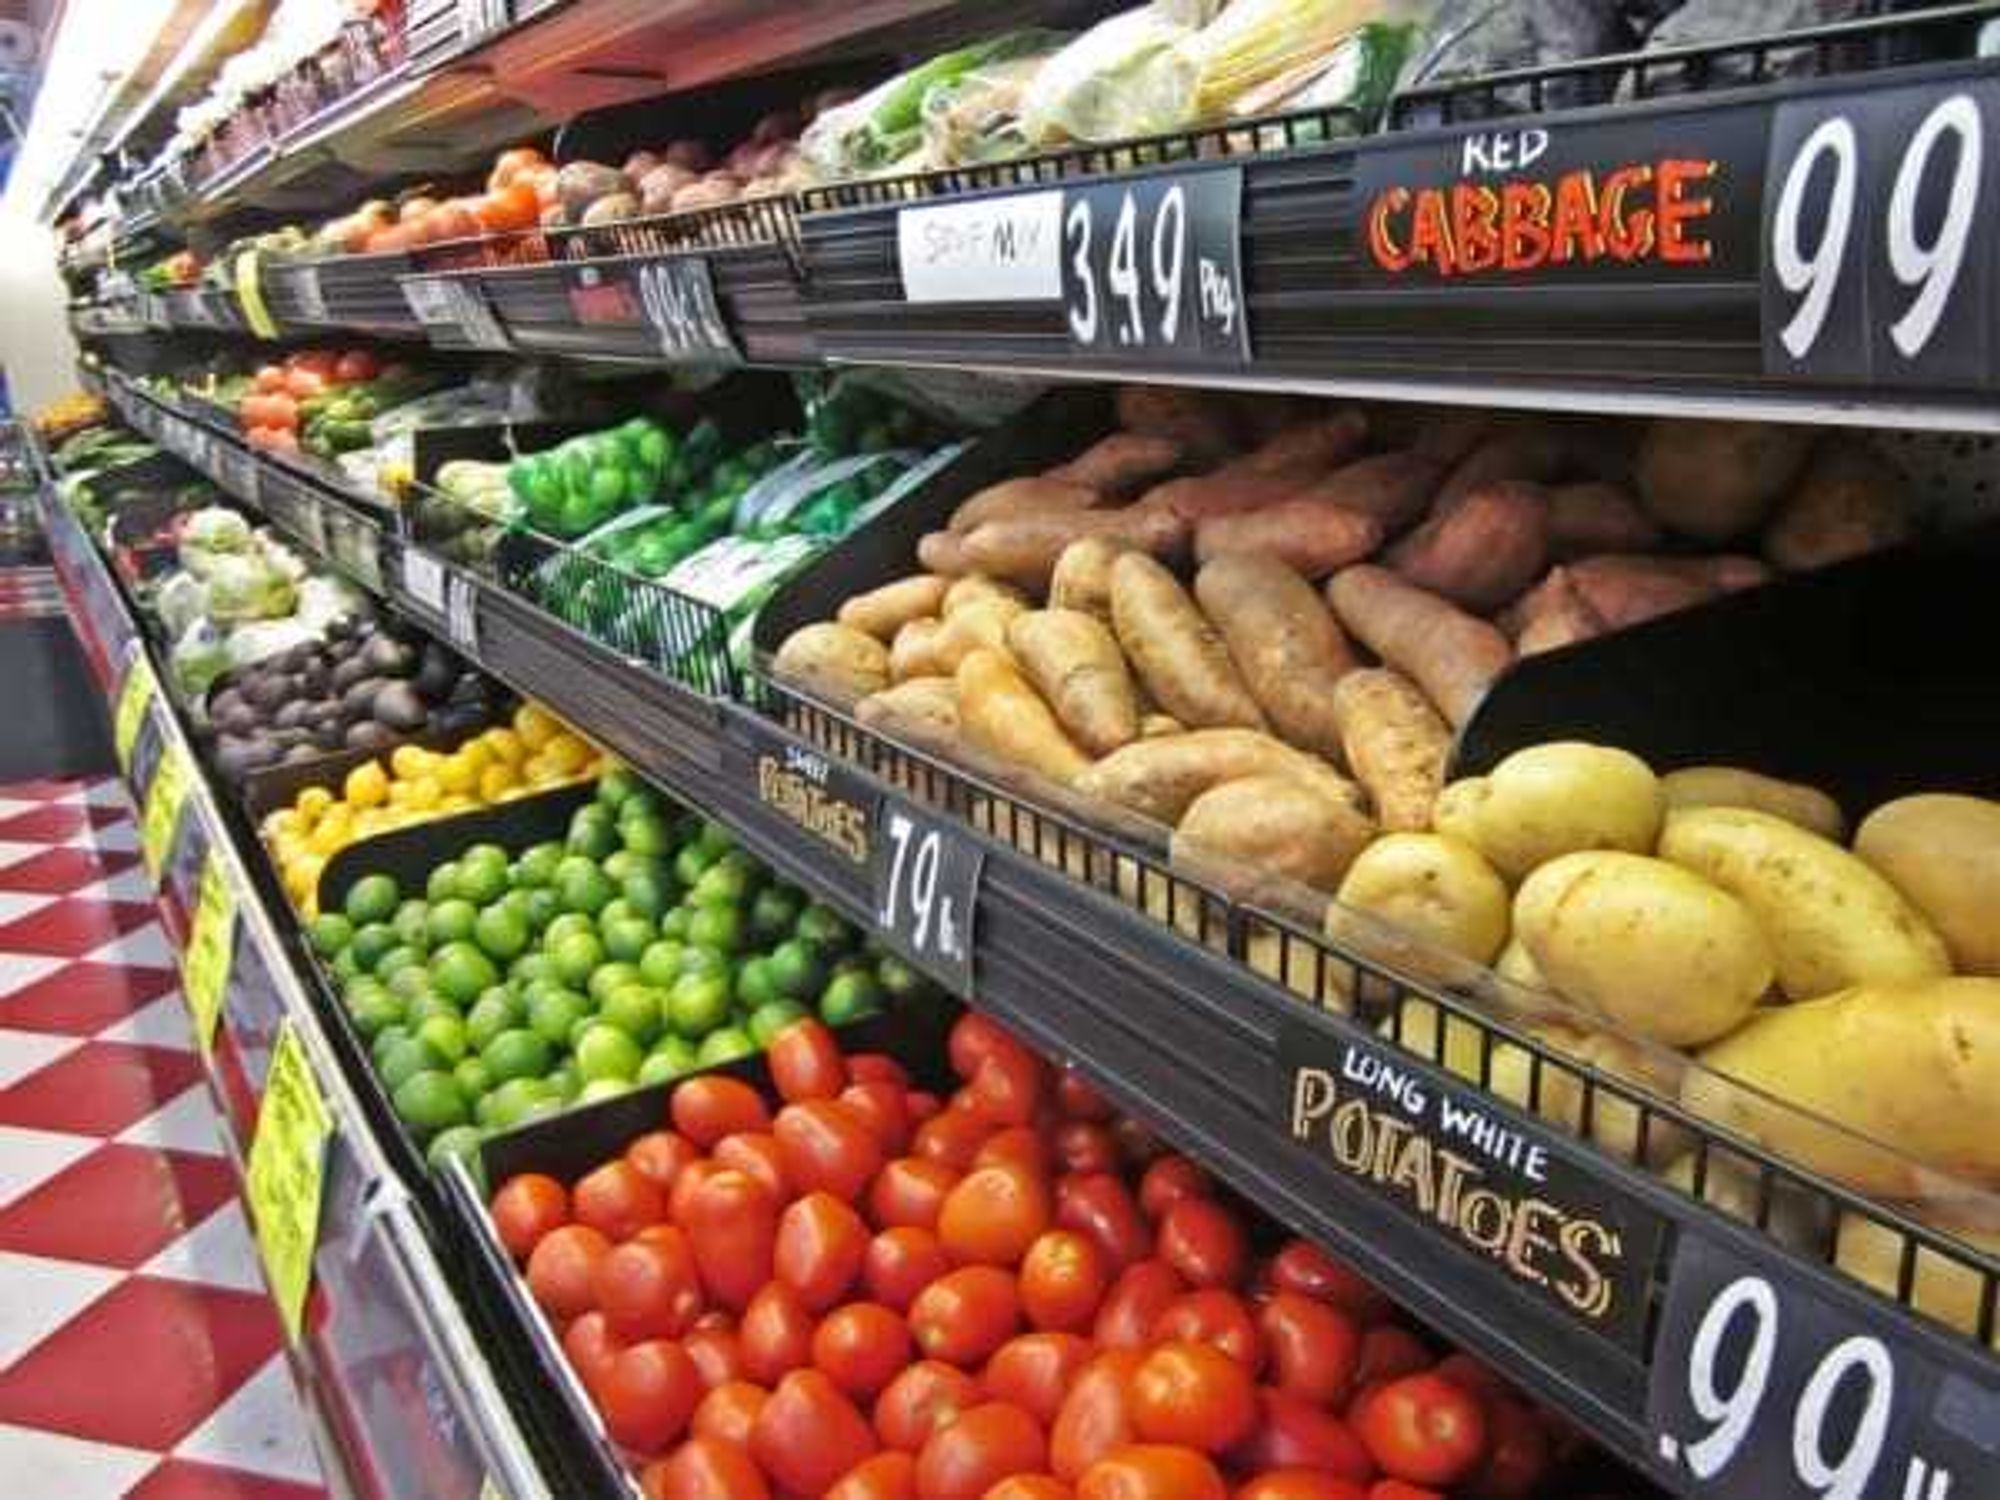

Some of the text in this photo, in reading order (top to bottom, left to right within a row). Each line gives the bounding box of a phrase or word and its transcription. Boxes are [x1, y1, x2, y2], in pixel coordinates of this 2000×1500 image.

[1367, 158, 1719, 276] CABBAGE
[1461, 129, 1549, 175] RED
[1772, 95, 1984, 359] 99
[1342, 1047, 1549, 1182] LONG WHITE
[1293, 1067, 1622, 1318] POTATOES
